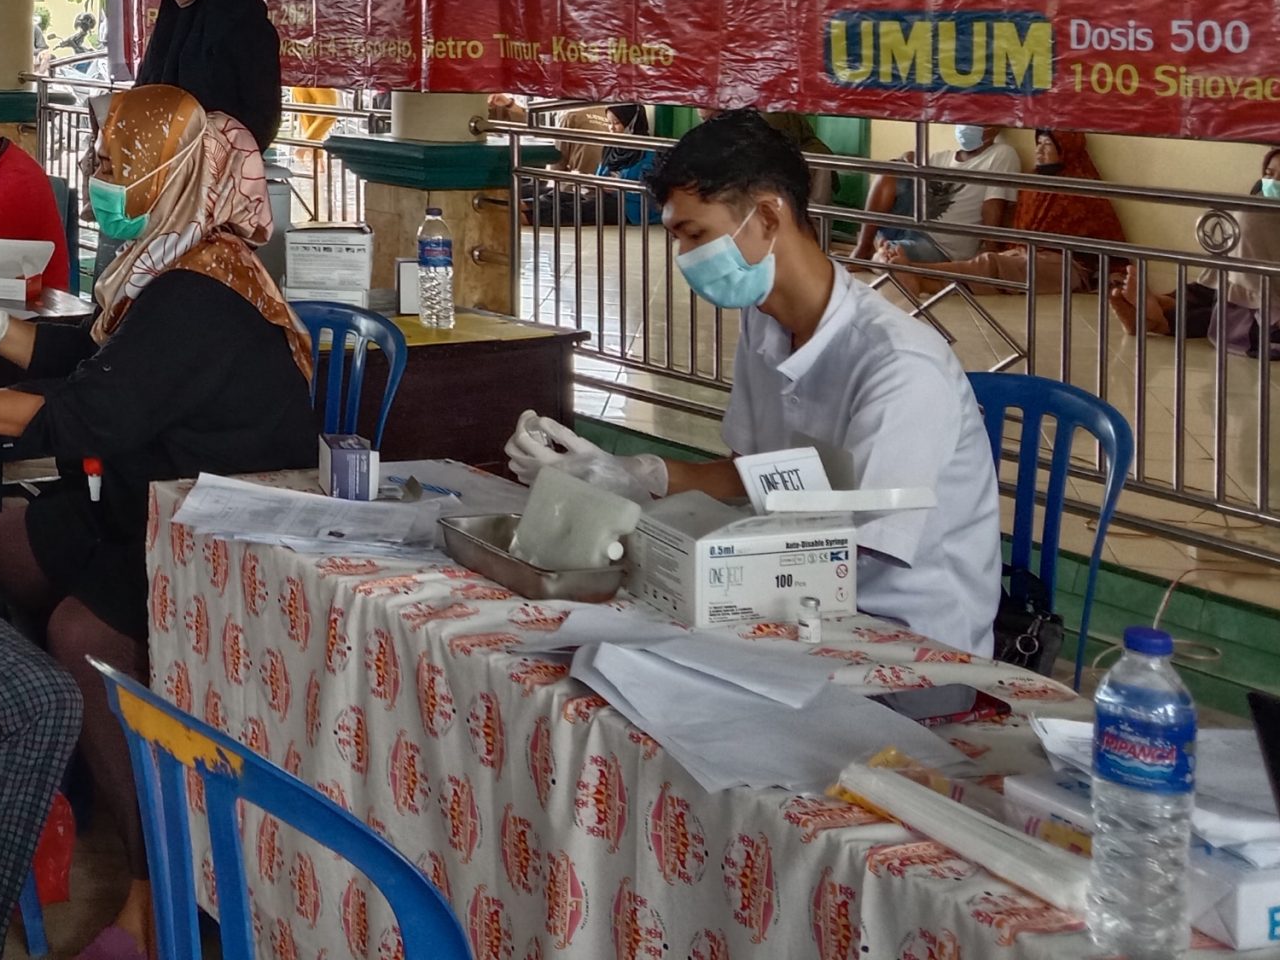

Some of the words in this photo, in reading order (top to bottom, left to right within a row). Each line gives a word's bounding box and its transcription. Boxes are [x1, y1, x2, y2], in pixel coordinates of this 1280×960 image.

[1070, 17, 1154, 52] Dosis
[1170, 19, 1250, 54] 500
[830, 19, 1054, 90] UMUM
[1070, 62, 1139, 96] 100
[1154, 65, 1280, 101] Sinovac
[709, 545, 735, 556] 0.5ml
[775, 574, 793, 589] 100
